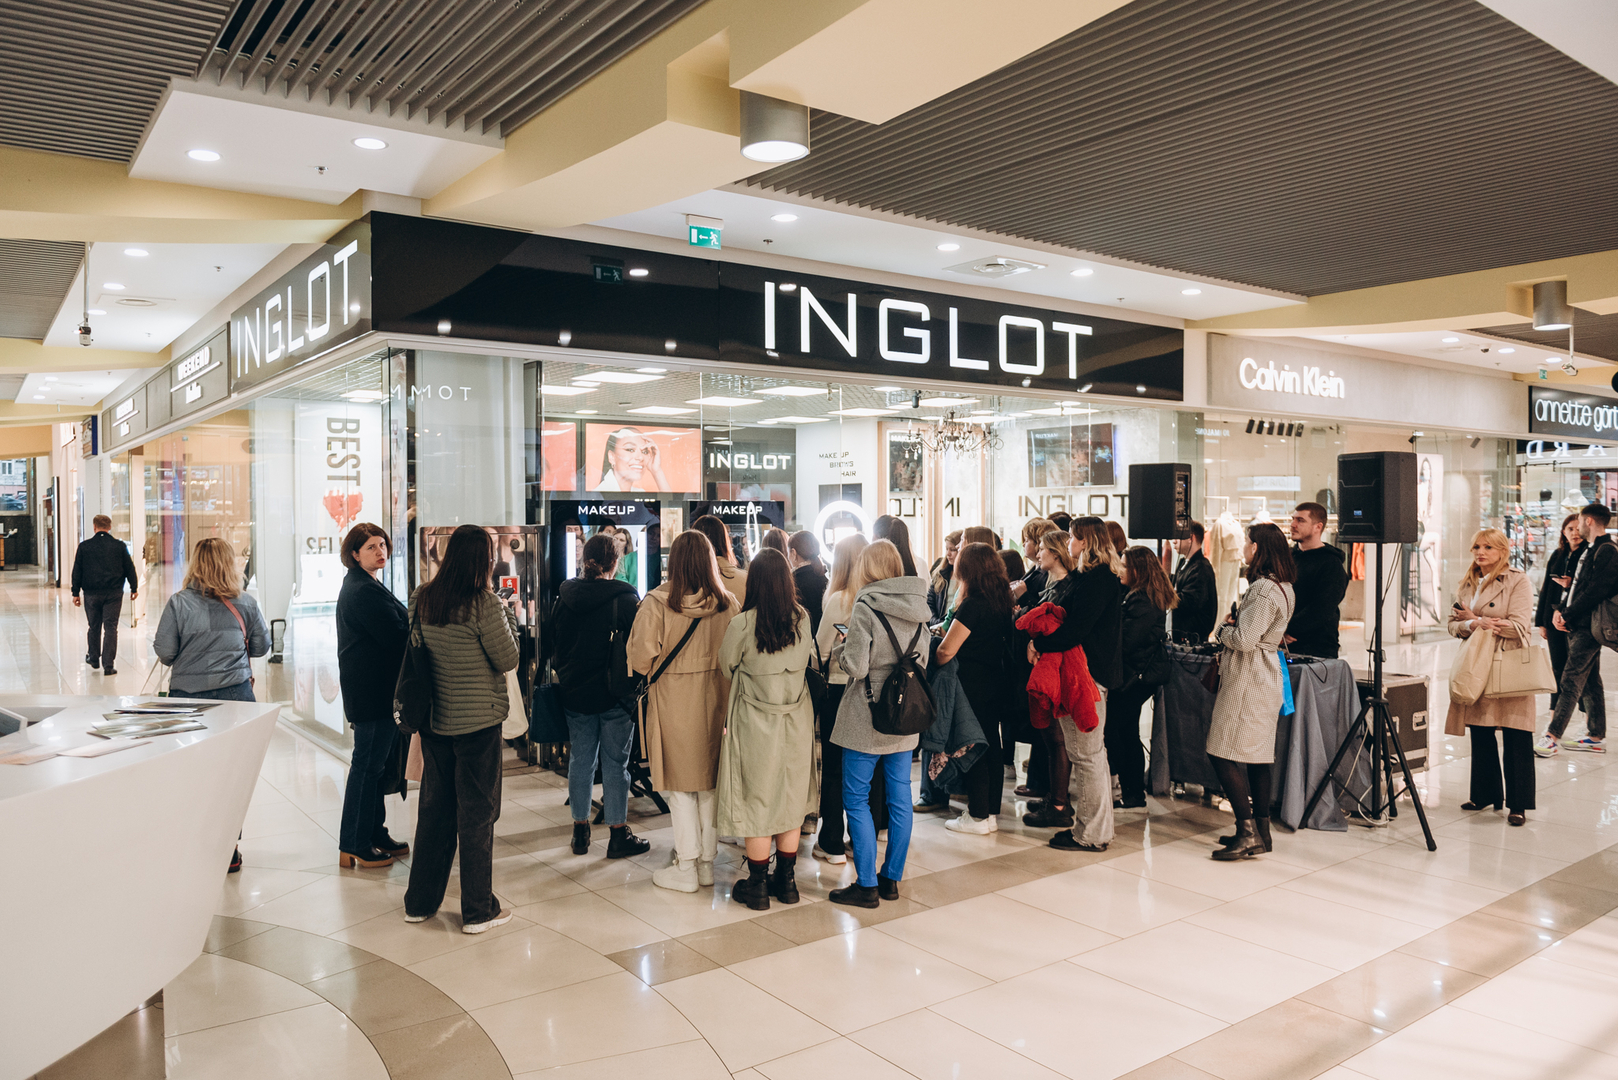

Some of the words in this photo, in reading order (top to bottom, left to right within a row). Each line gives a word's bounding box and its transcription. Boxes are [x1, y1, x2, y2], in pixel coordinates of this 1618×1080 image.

[236, 239, 358, 378] INGLOT
[764, 281, 1093, 379] INGLOT
[1239, 357, 1300, 394] Calvin
[1302, 365, 1345, 399] Klein
[1535, 399, 1592, 427] annette
[326, 417, 361, 486] BEST
[709, 453, 791, 470] INGLOT
[578, 505, 636, 516] MAKEUP
[1018, 494, 1129, 517] INGLOT
